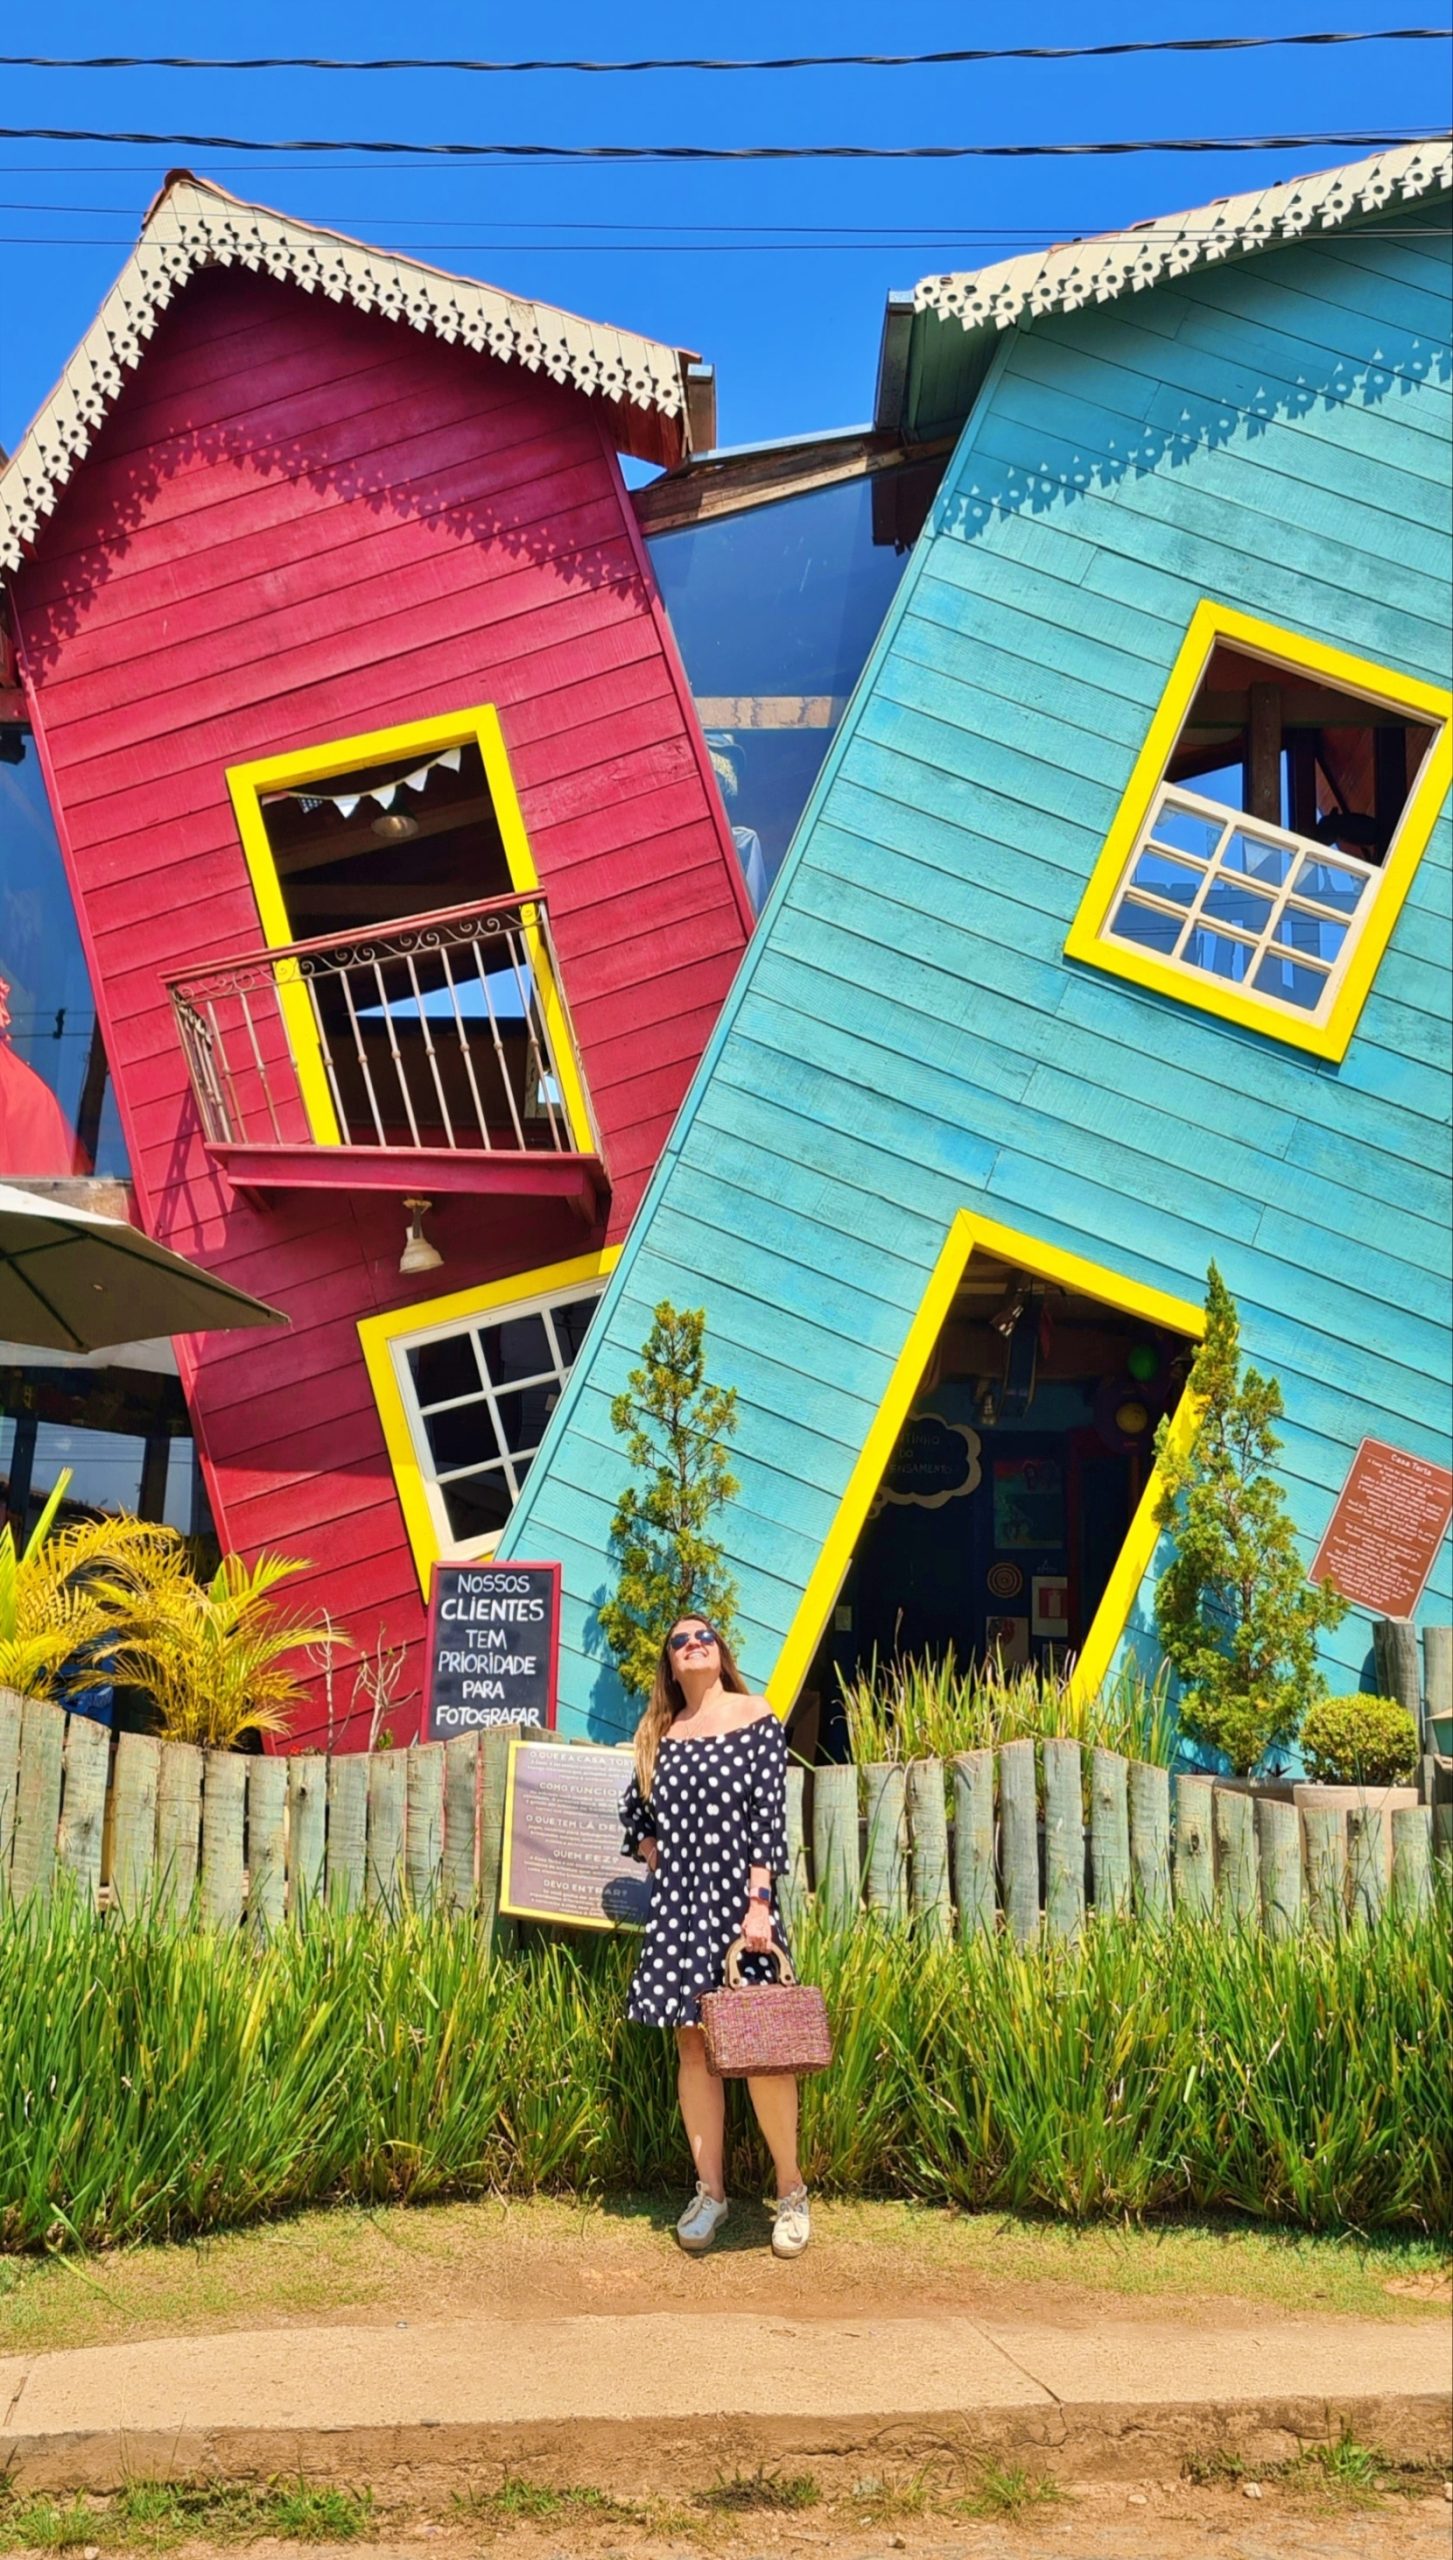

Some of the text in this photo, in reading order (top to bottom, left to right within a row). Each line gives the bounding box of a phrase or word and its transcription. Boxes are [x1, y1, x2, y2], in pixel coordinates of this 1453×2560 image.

[457, 1574, 530, 1593] NOSSOS
[441, 1596, 544, 1621] CLIENTES
[465, 1629, 507, 1650] TEM
[438, 1651, 537, 1675] PRIORIDADE
[462, 1680, 505, 1699] PARA
[436, 1705, 542, 1728] FOTOGRAFAR
[538, 1751, 559, 1760] QUE
[576, 1755, 607, 1764] CASA
[539, 1782, 568, 1791] COMO
[535, 1815, 554, 1825] QUE
[557, 1819, 577, 1829] TEM
[553, 1849, 619, 1864] QUEM FEZ?
[543, 1879, 628, 1897] DEVO ENTRAR?
